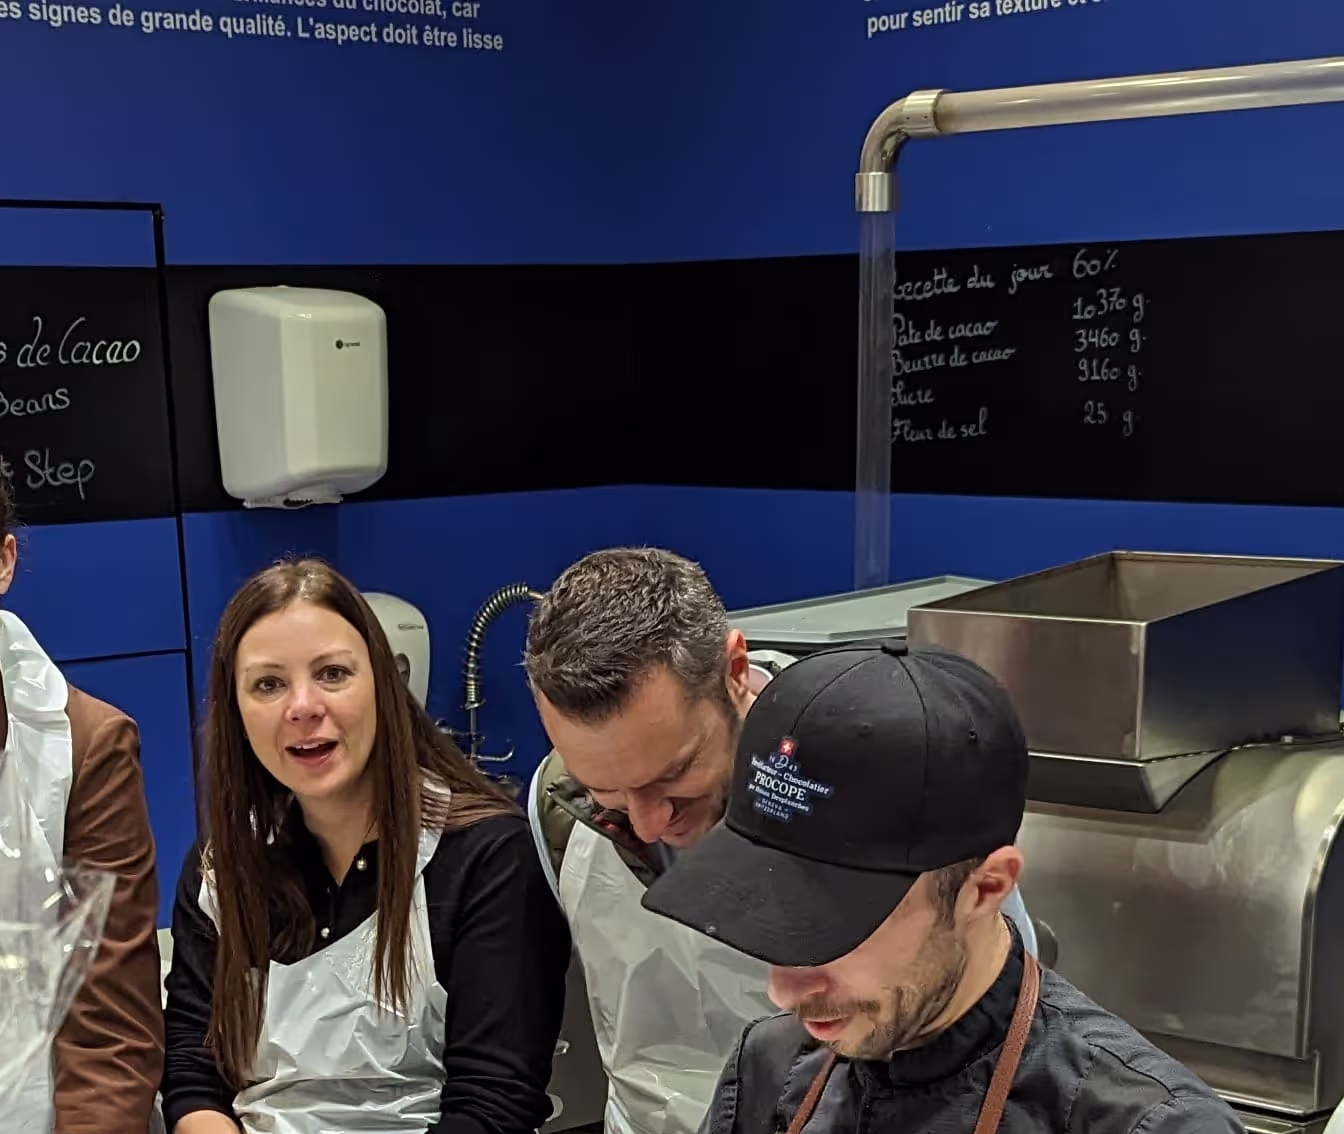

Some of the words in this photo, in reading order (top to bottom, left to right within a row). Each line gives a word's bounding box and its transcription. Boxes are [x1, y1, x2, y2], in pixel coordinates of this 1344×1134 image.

[29, 0, 102, 27] signes
[108, 3, 135, 26] de
[140, 9, 213, 33] grande
[219, 13, 292, 38] qualité.
[297, 17, 378, 44] L'aspect
[382, 23, 419, 45] doit
[422, 25, 457, 47] être
[462, 28, 504, 50] lisse
[452, 1, 480, 18] car
[867, 12, 908, 38] pour
[912, 0, 965, 27] sentir
[969, 1, 990, 19] sa
[967, 265, 995, 289] du
[1007, 261, 1055, 296] jour
[1071, 248, 1120, 280] 60%
[16, 316, 51, 370] de
[924, 323, 945, 342] de
[947, 318, 999, 341] cacao
[948, 346, 969, 367] de
[971, 346, 1016, 364] cacao
[937, 418, 957, 441] de
[960, 407, 990, 440] sel
[23, 448, 95, 500] Step
[754, 770, 807, 801] PROCOPE
[783, 772, 830, 795] Chocolatier
